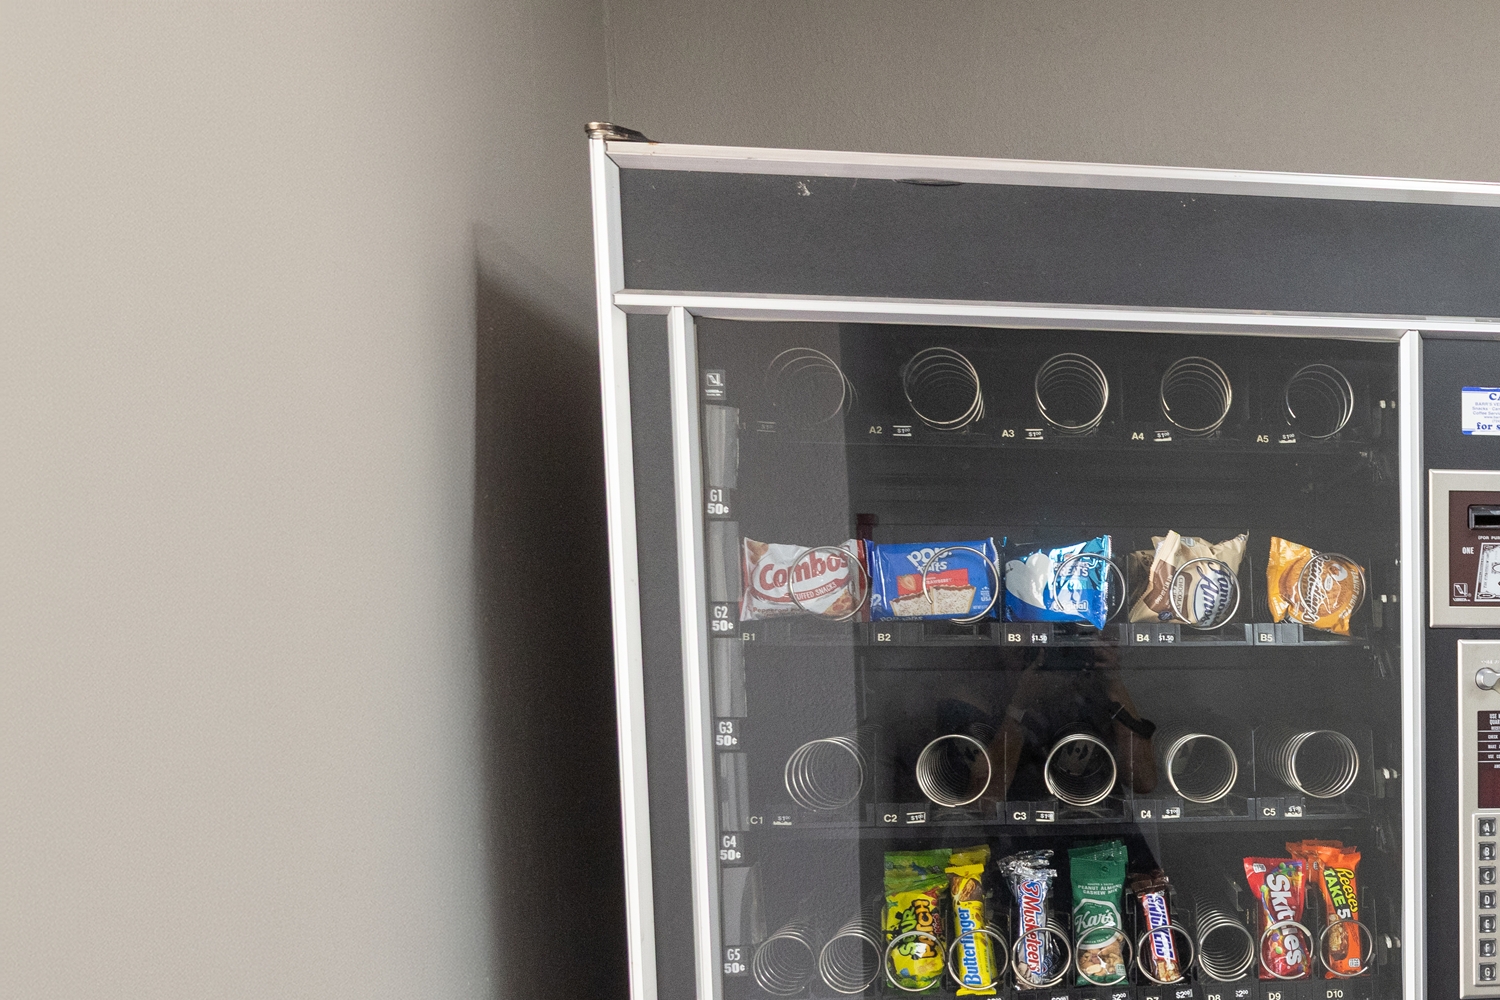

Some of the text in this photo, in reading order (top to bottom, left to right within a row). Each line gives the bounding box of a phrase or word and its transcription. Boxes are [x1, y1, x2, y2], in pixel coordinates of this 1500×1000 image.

[1476, 421, 1493, 430] for
[710, 489, 723, 502] G1
[759, 551, 849, 590] Combos
[815, 582, 838, 596] SNACKS
[1196, 566, 1220, 625] Amos
[714, 606, 728, 618] G2
[718, 721, 733, 734] G3
[723, 836, 736, 848] G4
[1324, 868, 1351, 920] TAKE 5
[1075, 910, 1115, 933] Kar's
[1267, 873, 1301, 966] Skittles
[1021, 880, 1042, 975] 3 Musketeers
[956, 907, 982, 986] Butterfinger
[727, 949, 740, 960] G5
[1268, 992, 1282, 1000] D9
[1326, 991, 1343, 999] D10
